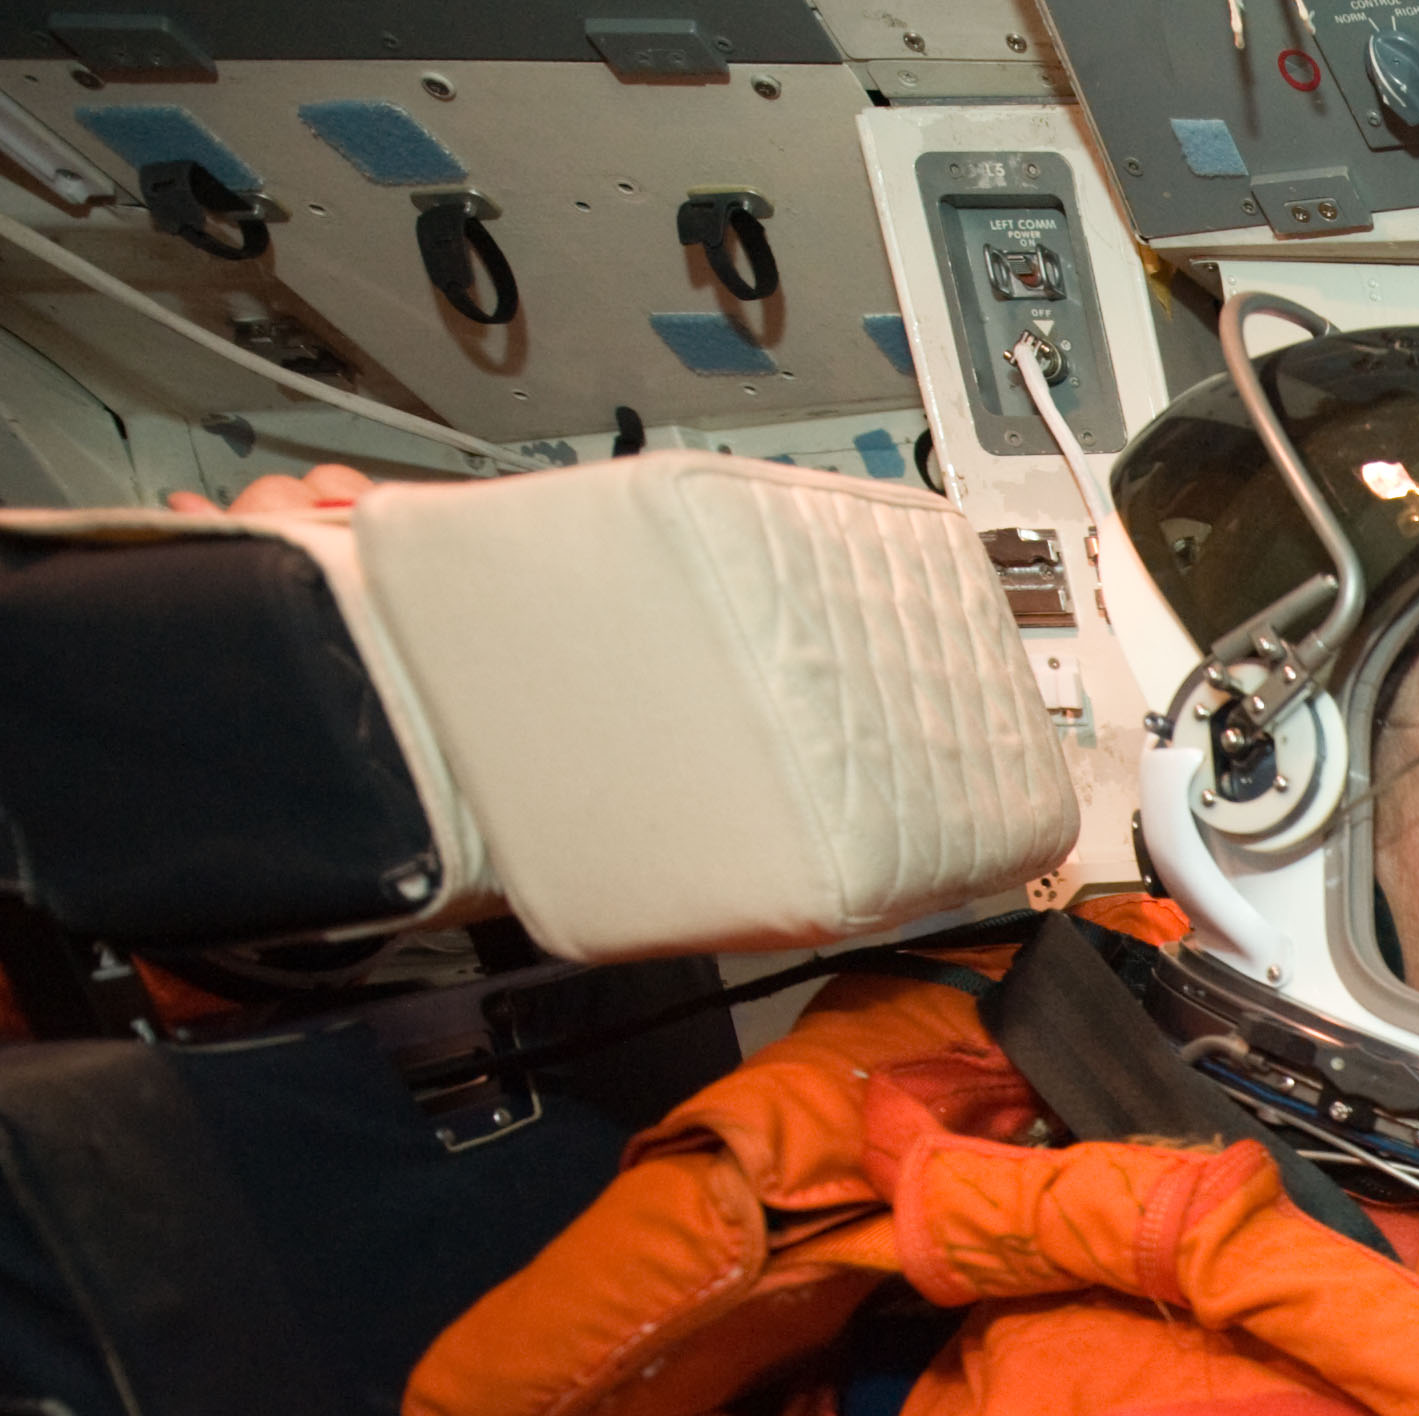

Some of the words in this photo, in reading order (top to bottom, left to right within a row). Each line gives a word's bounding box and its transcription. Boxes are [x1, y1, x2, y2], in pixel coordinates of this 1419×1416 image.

[1334, 12, 1367, 24] NORM
[989, 219, 1014, 231] LEFT
[1018, 219, 1057, 230] COMM
[1008, 231, 1041, 239] POWER
[1019, 239, 1036, 247] ON
[1031, 308, 1052, 318] OFF
